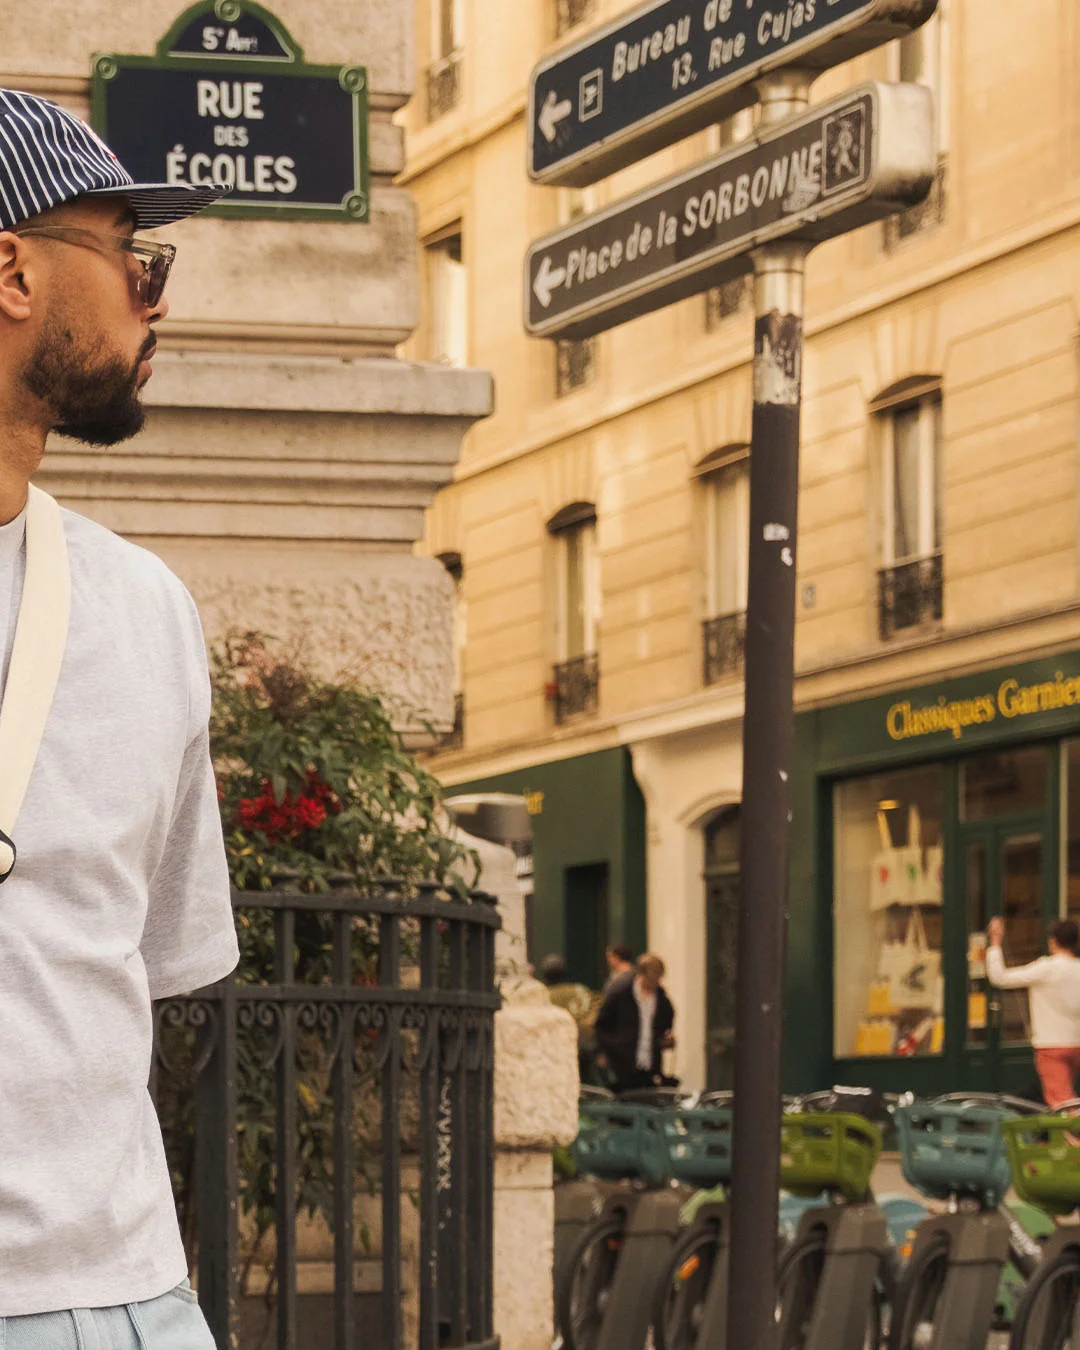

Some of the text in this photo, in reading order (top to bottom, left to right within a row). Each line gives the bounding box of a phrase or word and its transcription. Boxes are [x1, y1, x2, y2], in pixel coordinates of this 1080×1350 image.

[611, 0, 733, 83] Bureau de
[708, 32, 746, 72] Rue
[757, 0, 816, 46] Cujas
[197, 79, 265, 120] RUE
[213, 124, 250, 148] DES
[166, 143, 298, 194] ÉCOLES
[564, 140, 822, 290] Place de la SORBONNE
[886, 695, 996, 741] Classiques
